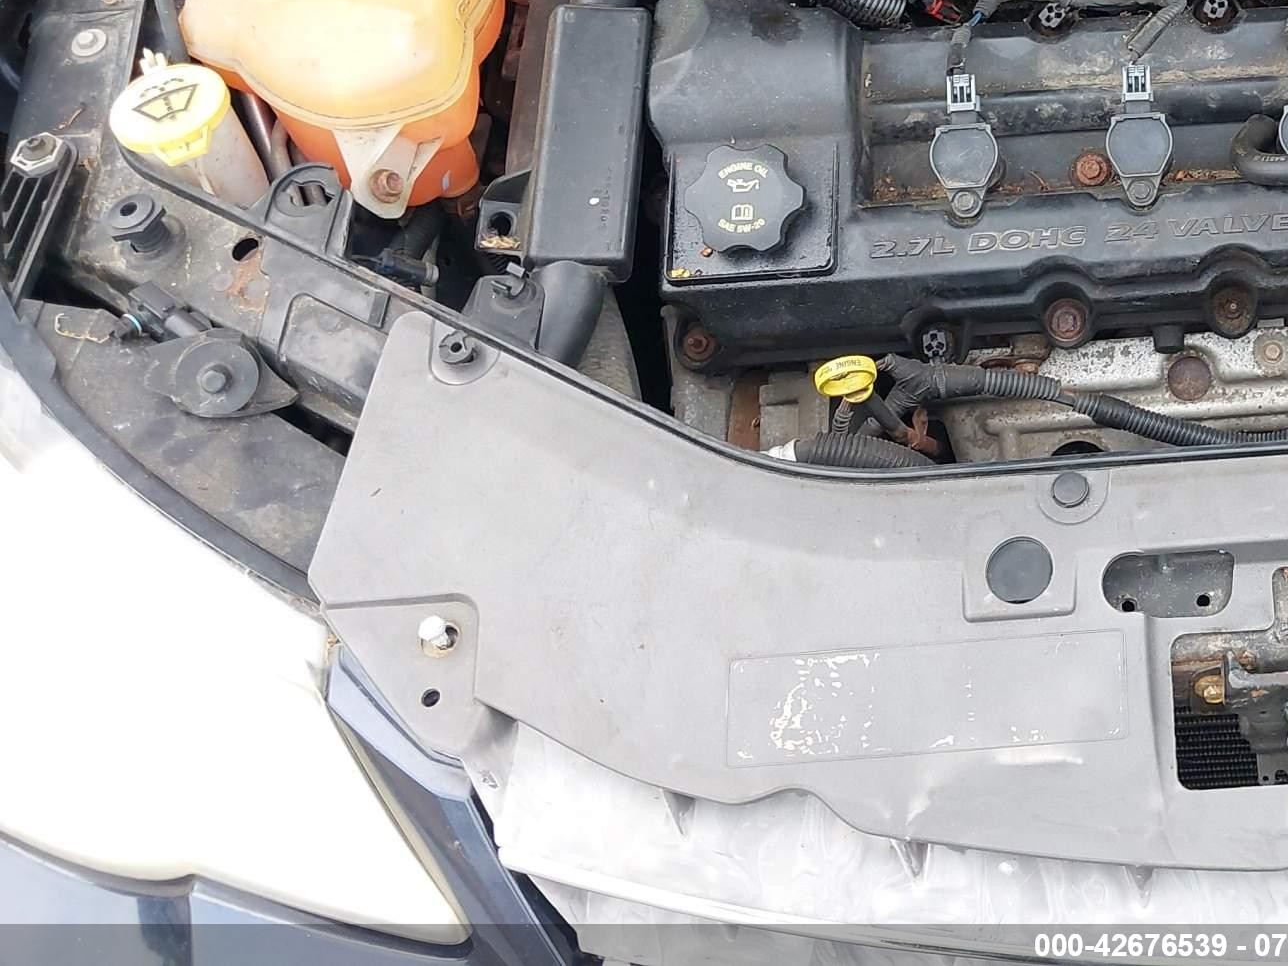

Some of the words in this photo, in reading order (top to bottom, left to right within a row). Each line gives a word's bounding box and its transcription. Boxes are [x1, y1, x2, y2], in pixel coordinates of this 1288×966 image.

[718, 161, 753, 179] ENGINE
[754, 164, 769, 178] OIL
[718, 218, 735, 232] SAE
[736, 218, 766, 233] 5W-20
[870, 235, 955, 259] 2.7L
[967, 225, 1087, 254] DOHC
[1103, 220, 1158, 243] 24
